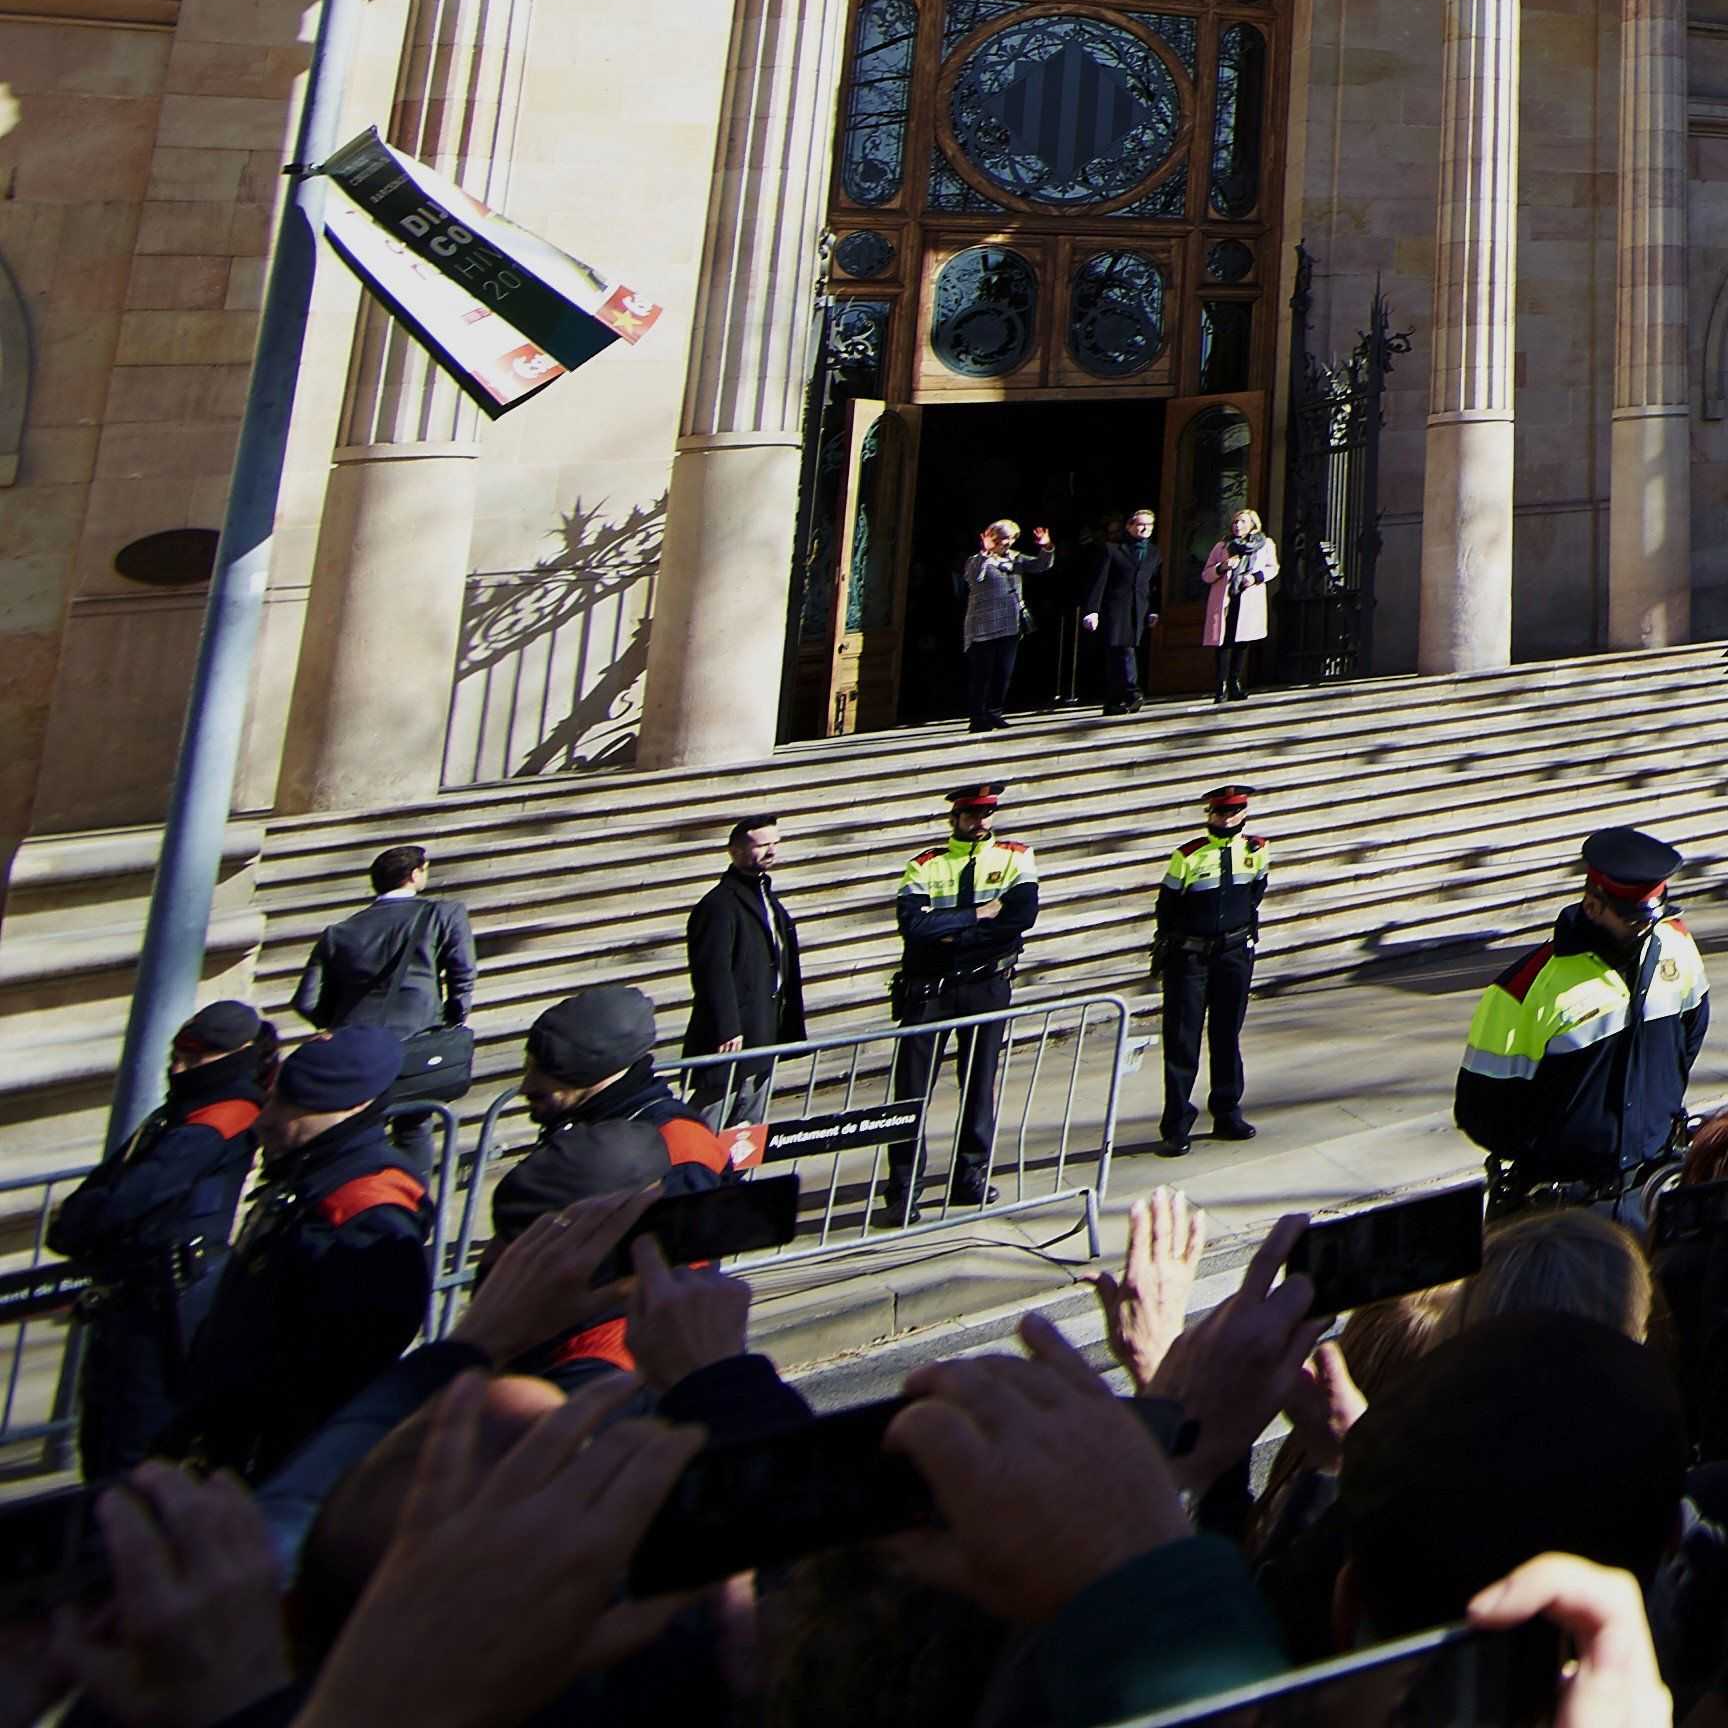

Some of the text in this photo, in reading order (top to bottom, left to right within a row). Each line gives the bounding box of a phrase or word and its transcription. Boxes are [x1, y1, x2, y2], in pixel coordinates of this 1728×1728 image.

[768, 1112, 916, 1149] Ajuntament de Barcelona
